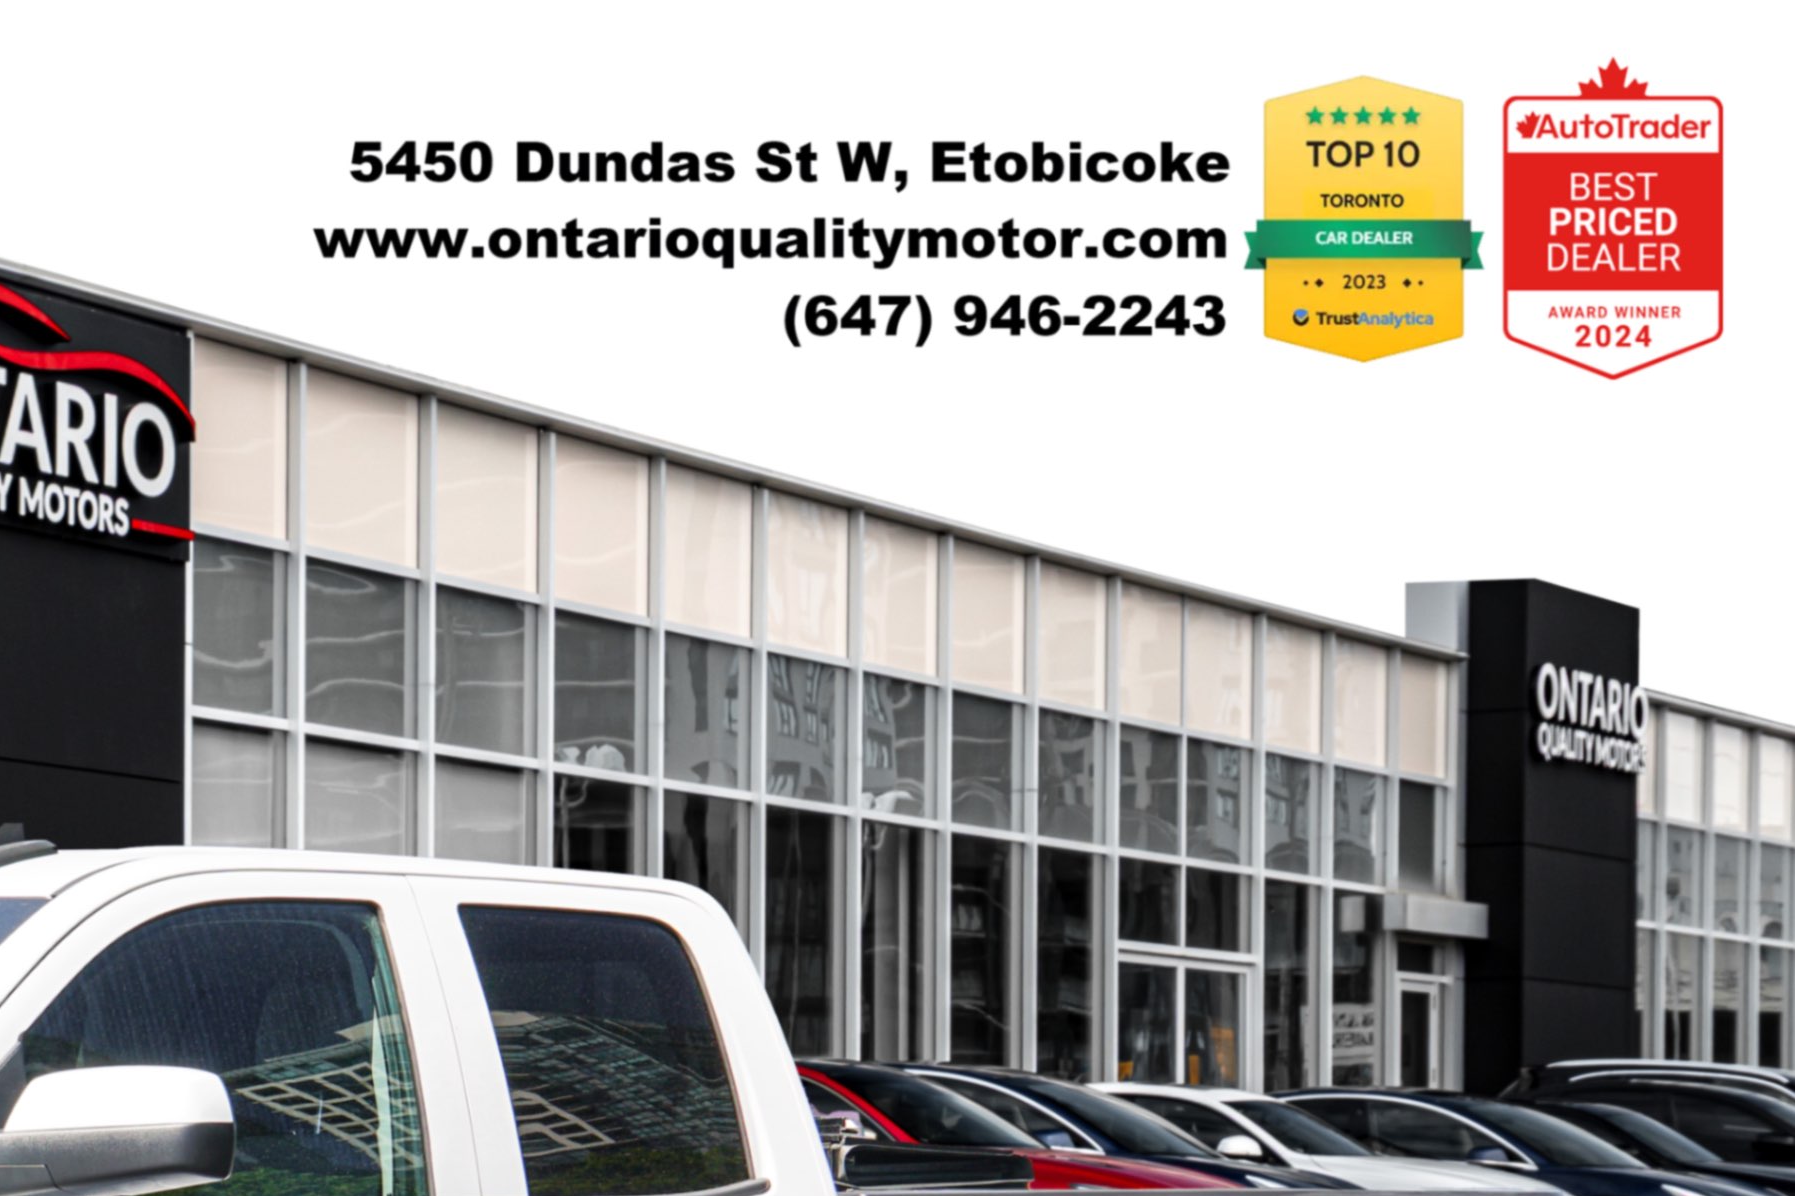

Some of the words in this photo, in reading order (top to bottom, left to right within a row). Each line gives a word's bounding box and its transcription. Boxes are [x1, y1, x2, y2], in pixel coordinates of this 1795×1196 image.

[18, 477, 131, 537] MOTORS
[1537, 661, 1649, 742] ONTARIO
[1537, 721, 1595, 764] QUALITY
